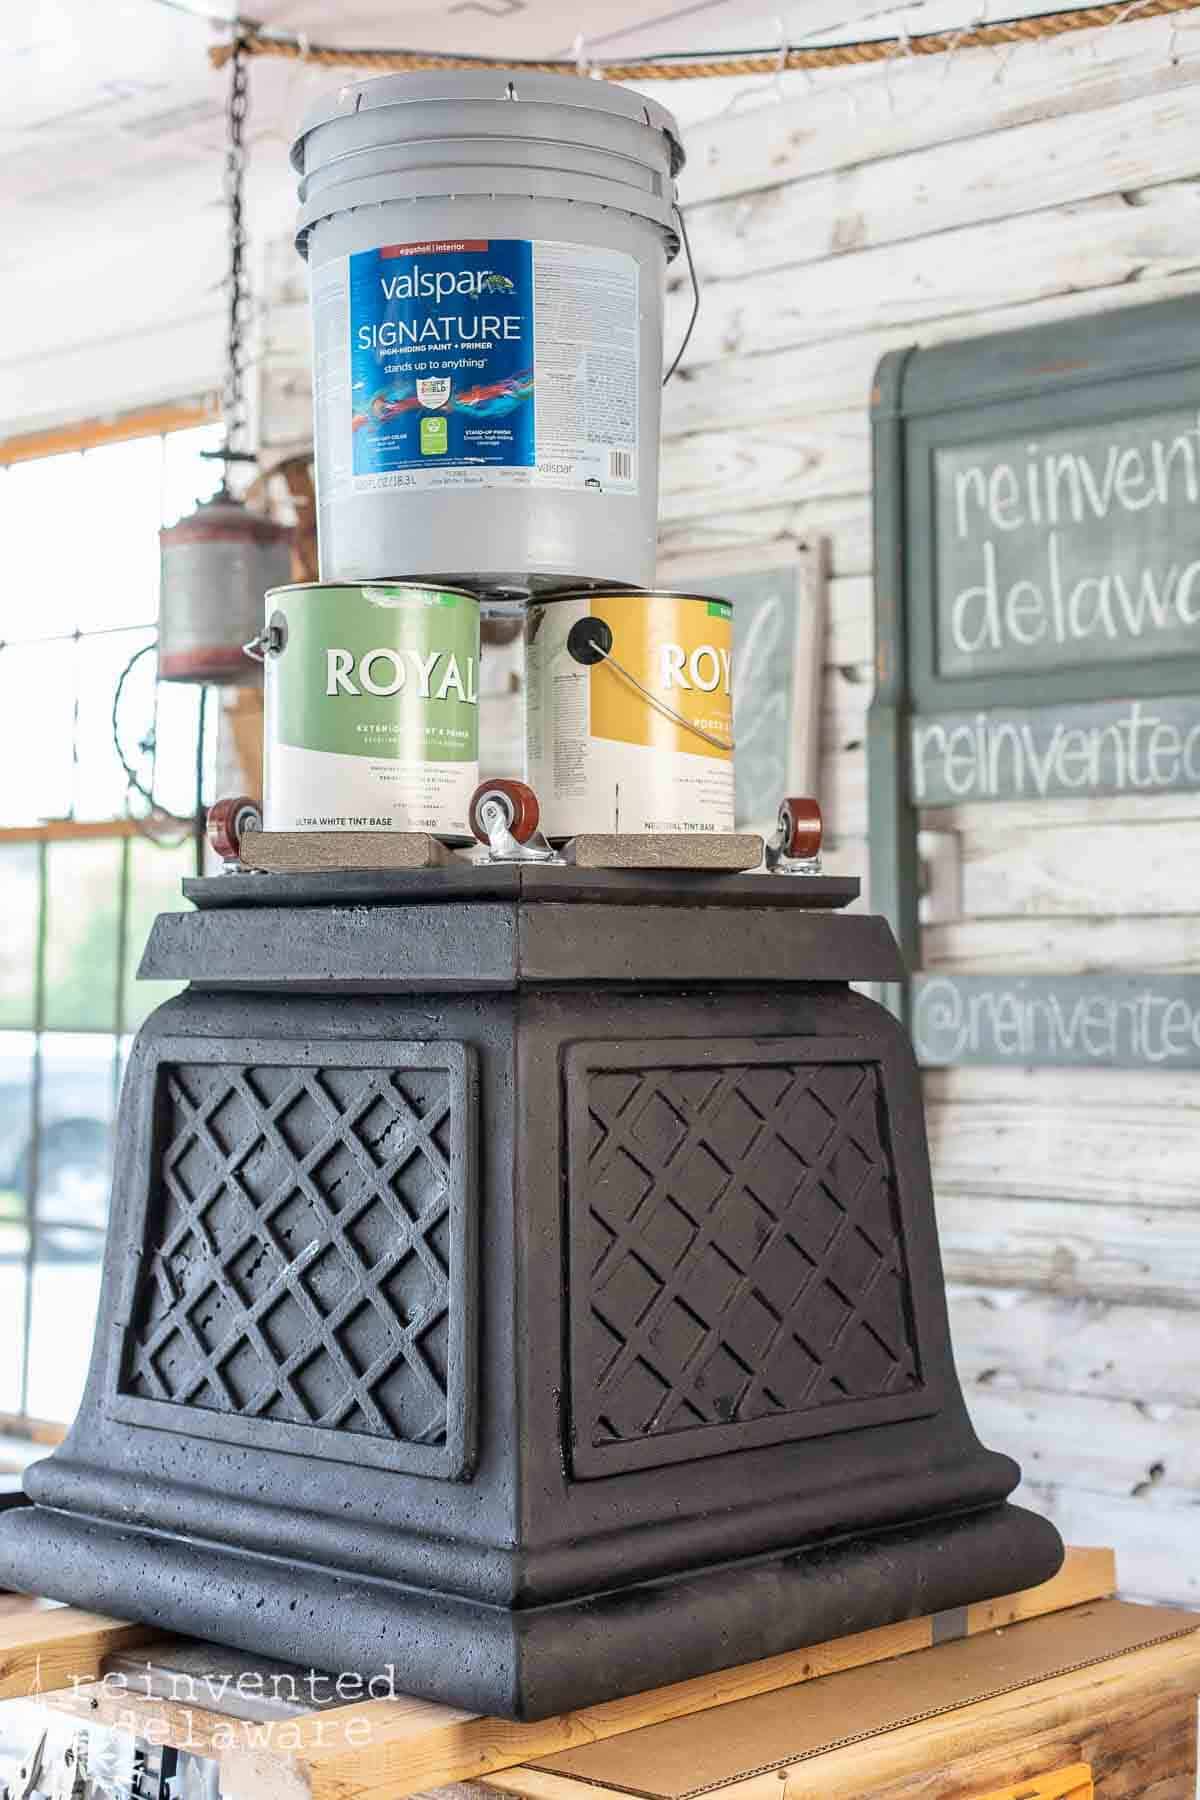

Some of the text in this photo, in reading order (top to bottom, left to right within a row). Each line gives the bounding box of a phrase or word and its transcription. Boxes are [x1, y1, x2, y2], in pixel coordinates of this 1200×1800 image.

[381, 265, 489, 303] valspar
[357, 315, 521, 350] SIGNATURE
[379, 345, 427, 356] HIGH-HIDING
[427, 342, 452, 352] PAINT
[460, 341, 493, 350] PRIMER
[383, 357, 486, 374] stands up to anything
[537, 463, 575, 474] valspar
[326, 647, 478, 704] ROYAL
[356, 723, 408, 734] EXTERIO
[319, 817, 346, 826] WHITE
[349, 817, 367, 826] TINT
[369, 817, 393, 826] BASE
[644, 822, 682, 831] NEAL
